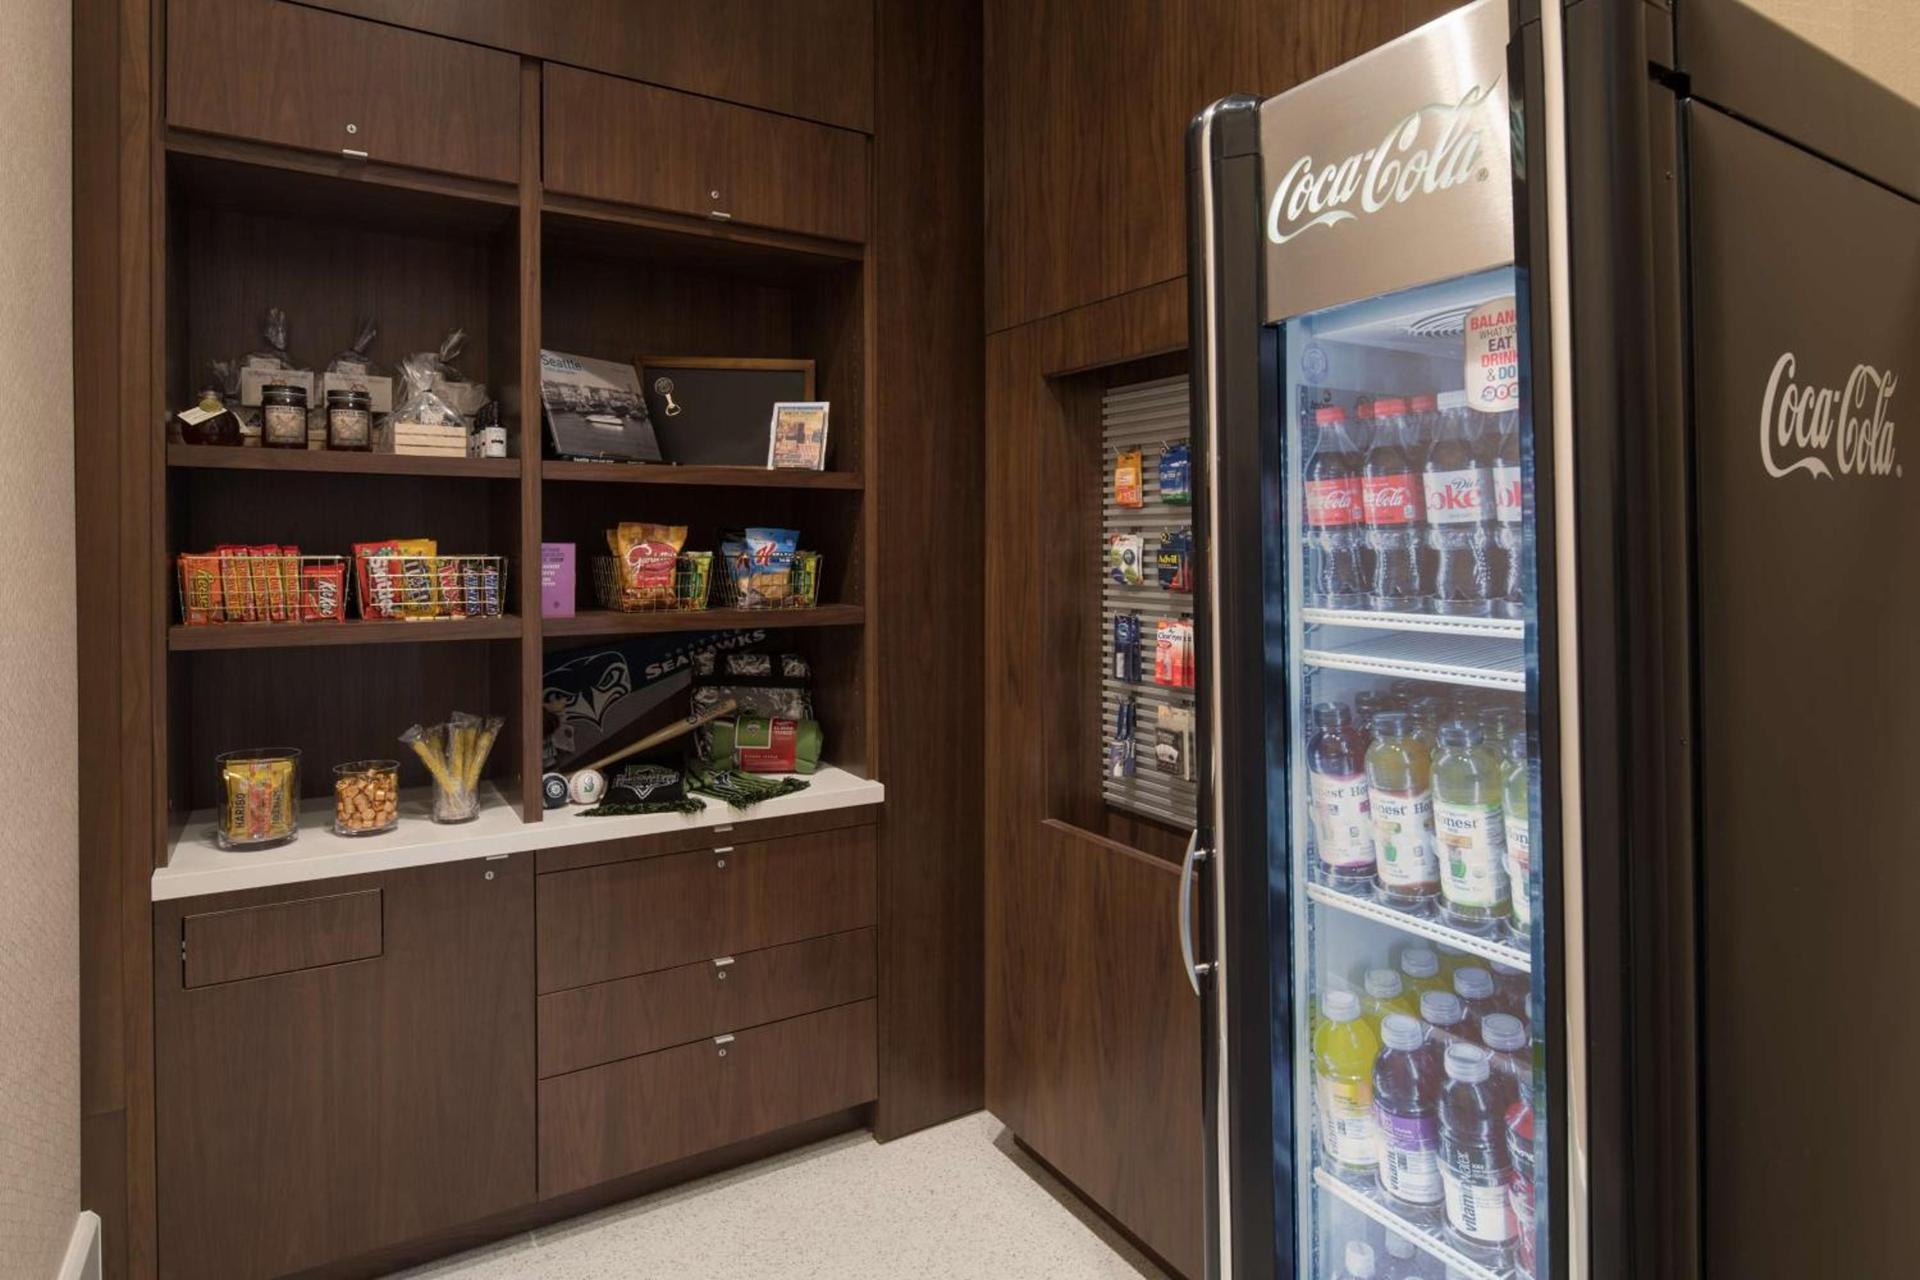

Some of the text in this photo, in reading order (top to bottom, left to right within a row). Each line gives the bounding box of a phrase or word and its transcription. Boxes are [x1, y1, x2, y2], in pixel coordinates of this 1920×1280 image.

[1267, 75, 1501, 244] Coca-Cola
[1480, 326, 1502, 339] WHAT
[1488, 336, 1513, 352] EAT
[1498, 364, 1517, 380] DO
[1760, 352, 1899, 482] Coca-Cola
[1158, 553, 1178, 565] Advil
[366, 558, 393, 617] Skittles
[235, 792, 246, 829] HARIBO
